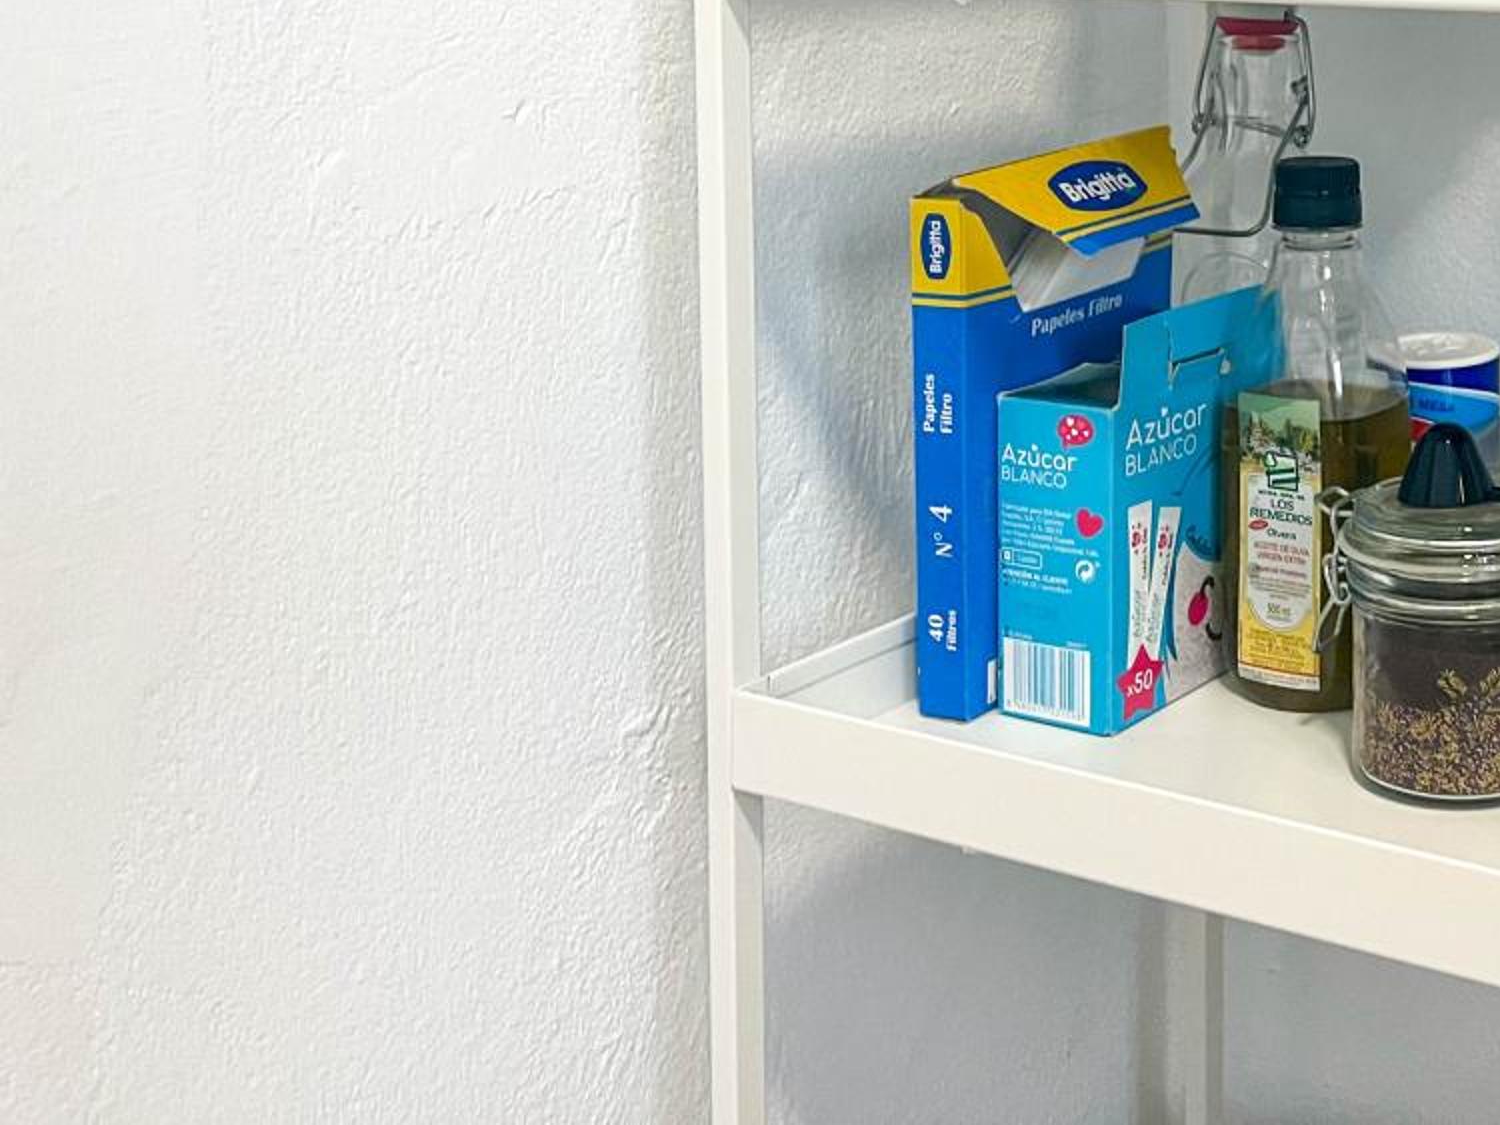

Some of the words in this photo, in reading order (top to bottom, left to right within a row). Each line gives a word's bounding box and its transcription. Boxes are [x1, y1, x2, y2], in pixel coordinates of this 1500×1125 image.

[1058, 170, 1137, 203] Brigitta
[929, 220, 945, 274] Brigitta
[1031, 307, 1086, 336] Papeles
[1088, 294, 1123, 318] Filtro
[923, 374, 935, 433] Papeles
[940, 393, 953, 434] Filtro
[1125, 403, 1208, 452] Azúcar
[1001, 442, 1078, 472] Azúcar
[1124, 433, 1197, 477] BLANCO
[1001, 465, 1068, 489] BLANCO
[928, 504, 953, 523] 4
[1249, 507, 1312, 526] REMEDIOS
[1270, 498, 1295, 512] LOS
[928, 614, 945, 641] 40
[946, 610, 957, 651] Filtros
[1126, 669, 1154, 698] x50
